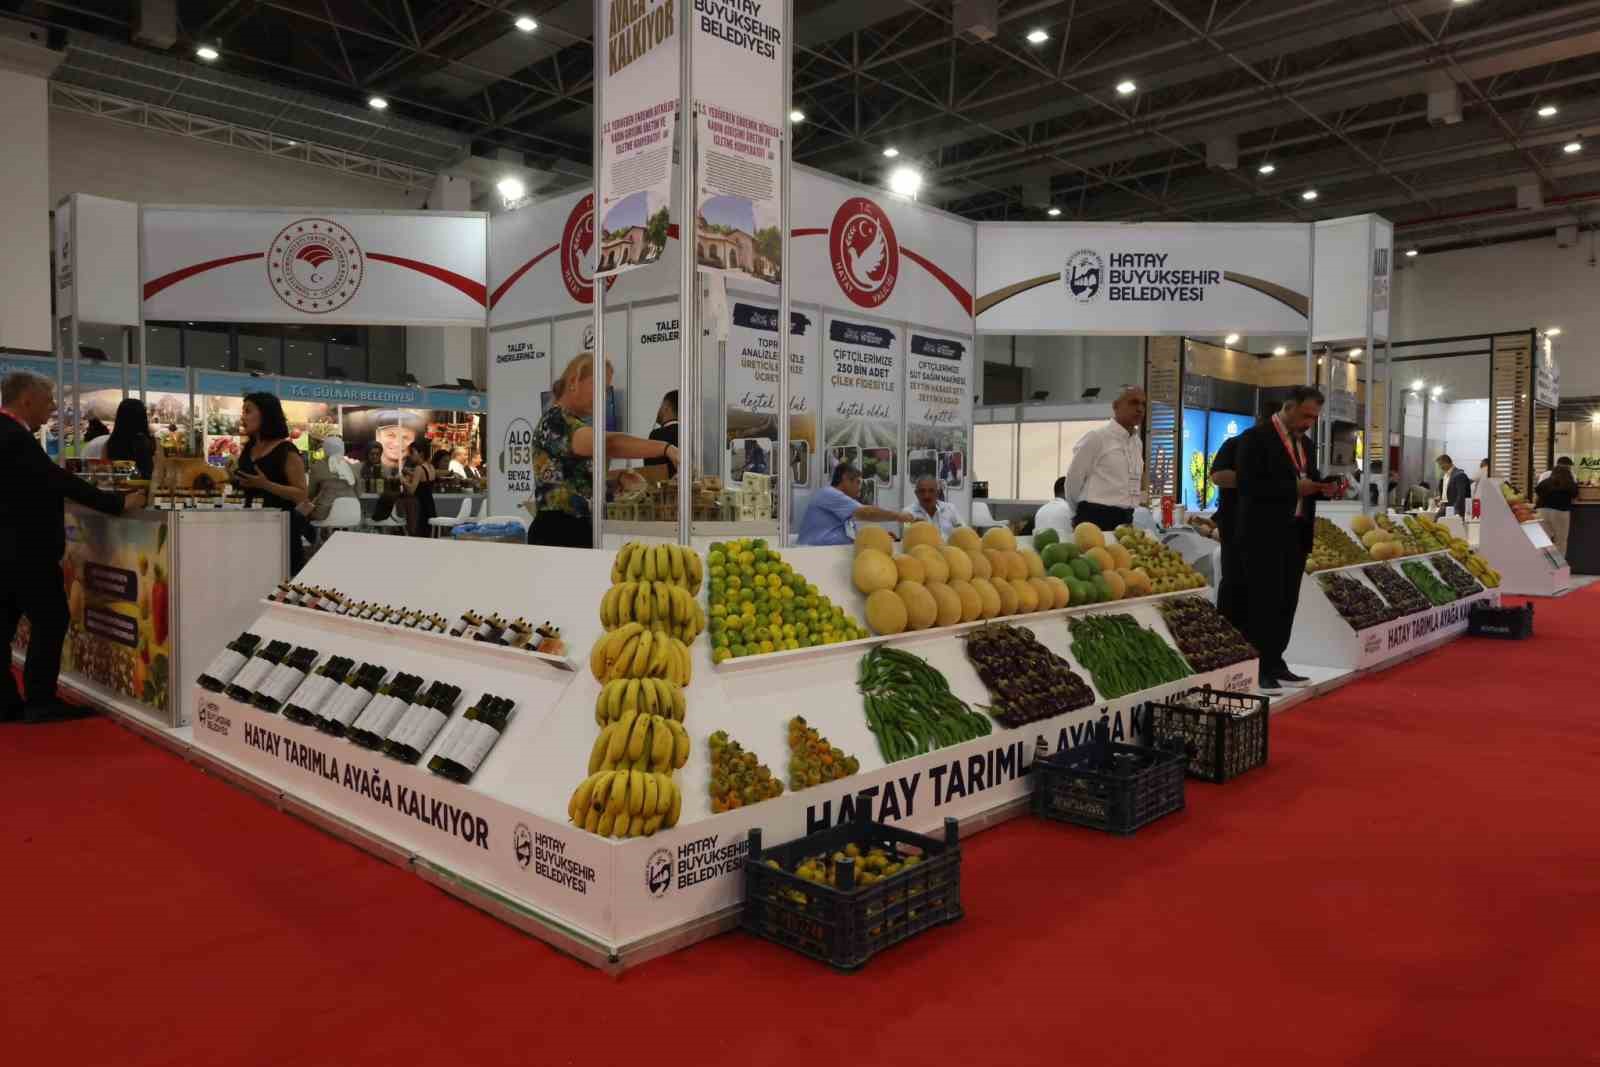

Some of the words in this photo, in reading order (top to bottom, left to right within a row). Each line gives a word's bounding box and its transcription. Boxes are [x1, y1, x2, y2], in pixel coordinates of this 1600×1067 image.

[609, 1, 674, 76] KALKIYOR
[701, 15, 776, 60] BELEDİYESİ
[1109, 253, 1168, 268] HATAY
[1109, 286, 1204, 302] BELEDİYESİ
[869, 367, 890, 378] ADET
[510, 430, 530, 445] ALO
[510, 446, 530, 465] 153
[508, 470, 531, 480] BEYAZ
[1388, 623, 1410, 648] HATAY
[244, 721, 283, 757] HATAY
[284, 737, 339, 784] TARIMLA
[343, 766, 393, 809] AYAĞA
[398, 784, 488, 850] KALKIYOR
[535, 831, 566, 854] HATAY
[678, 835, 718, 859] HATAY
[535, 861, 586, 895] BELEDİYESİ
